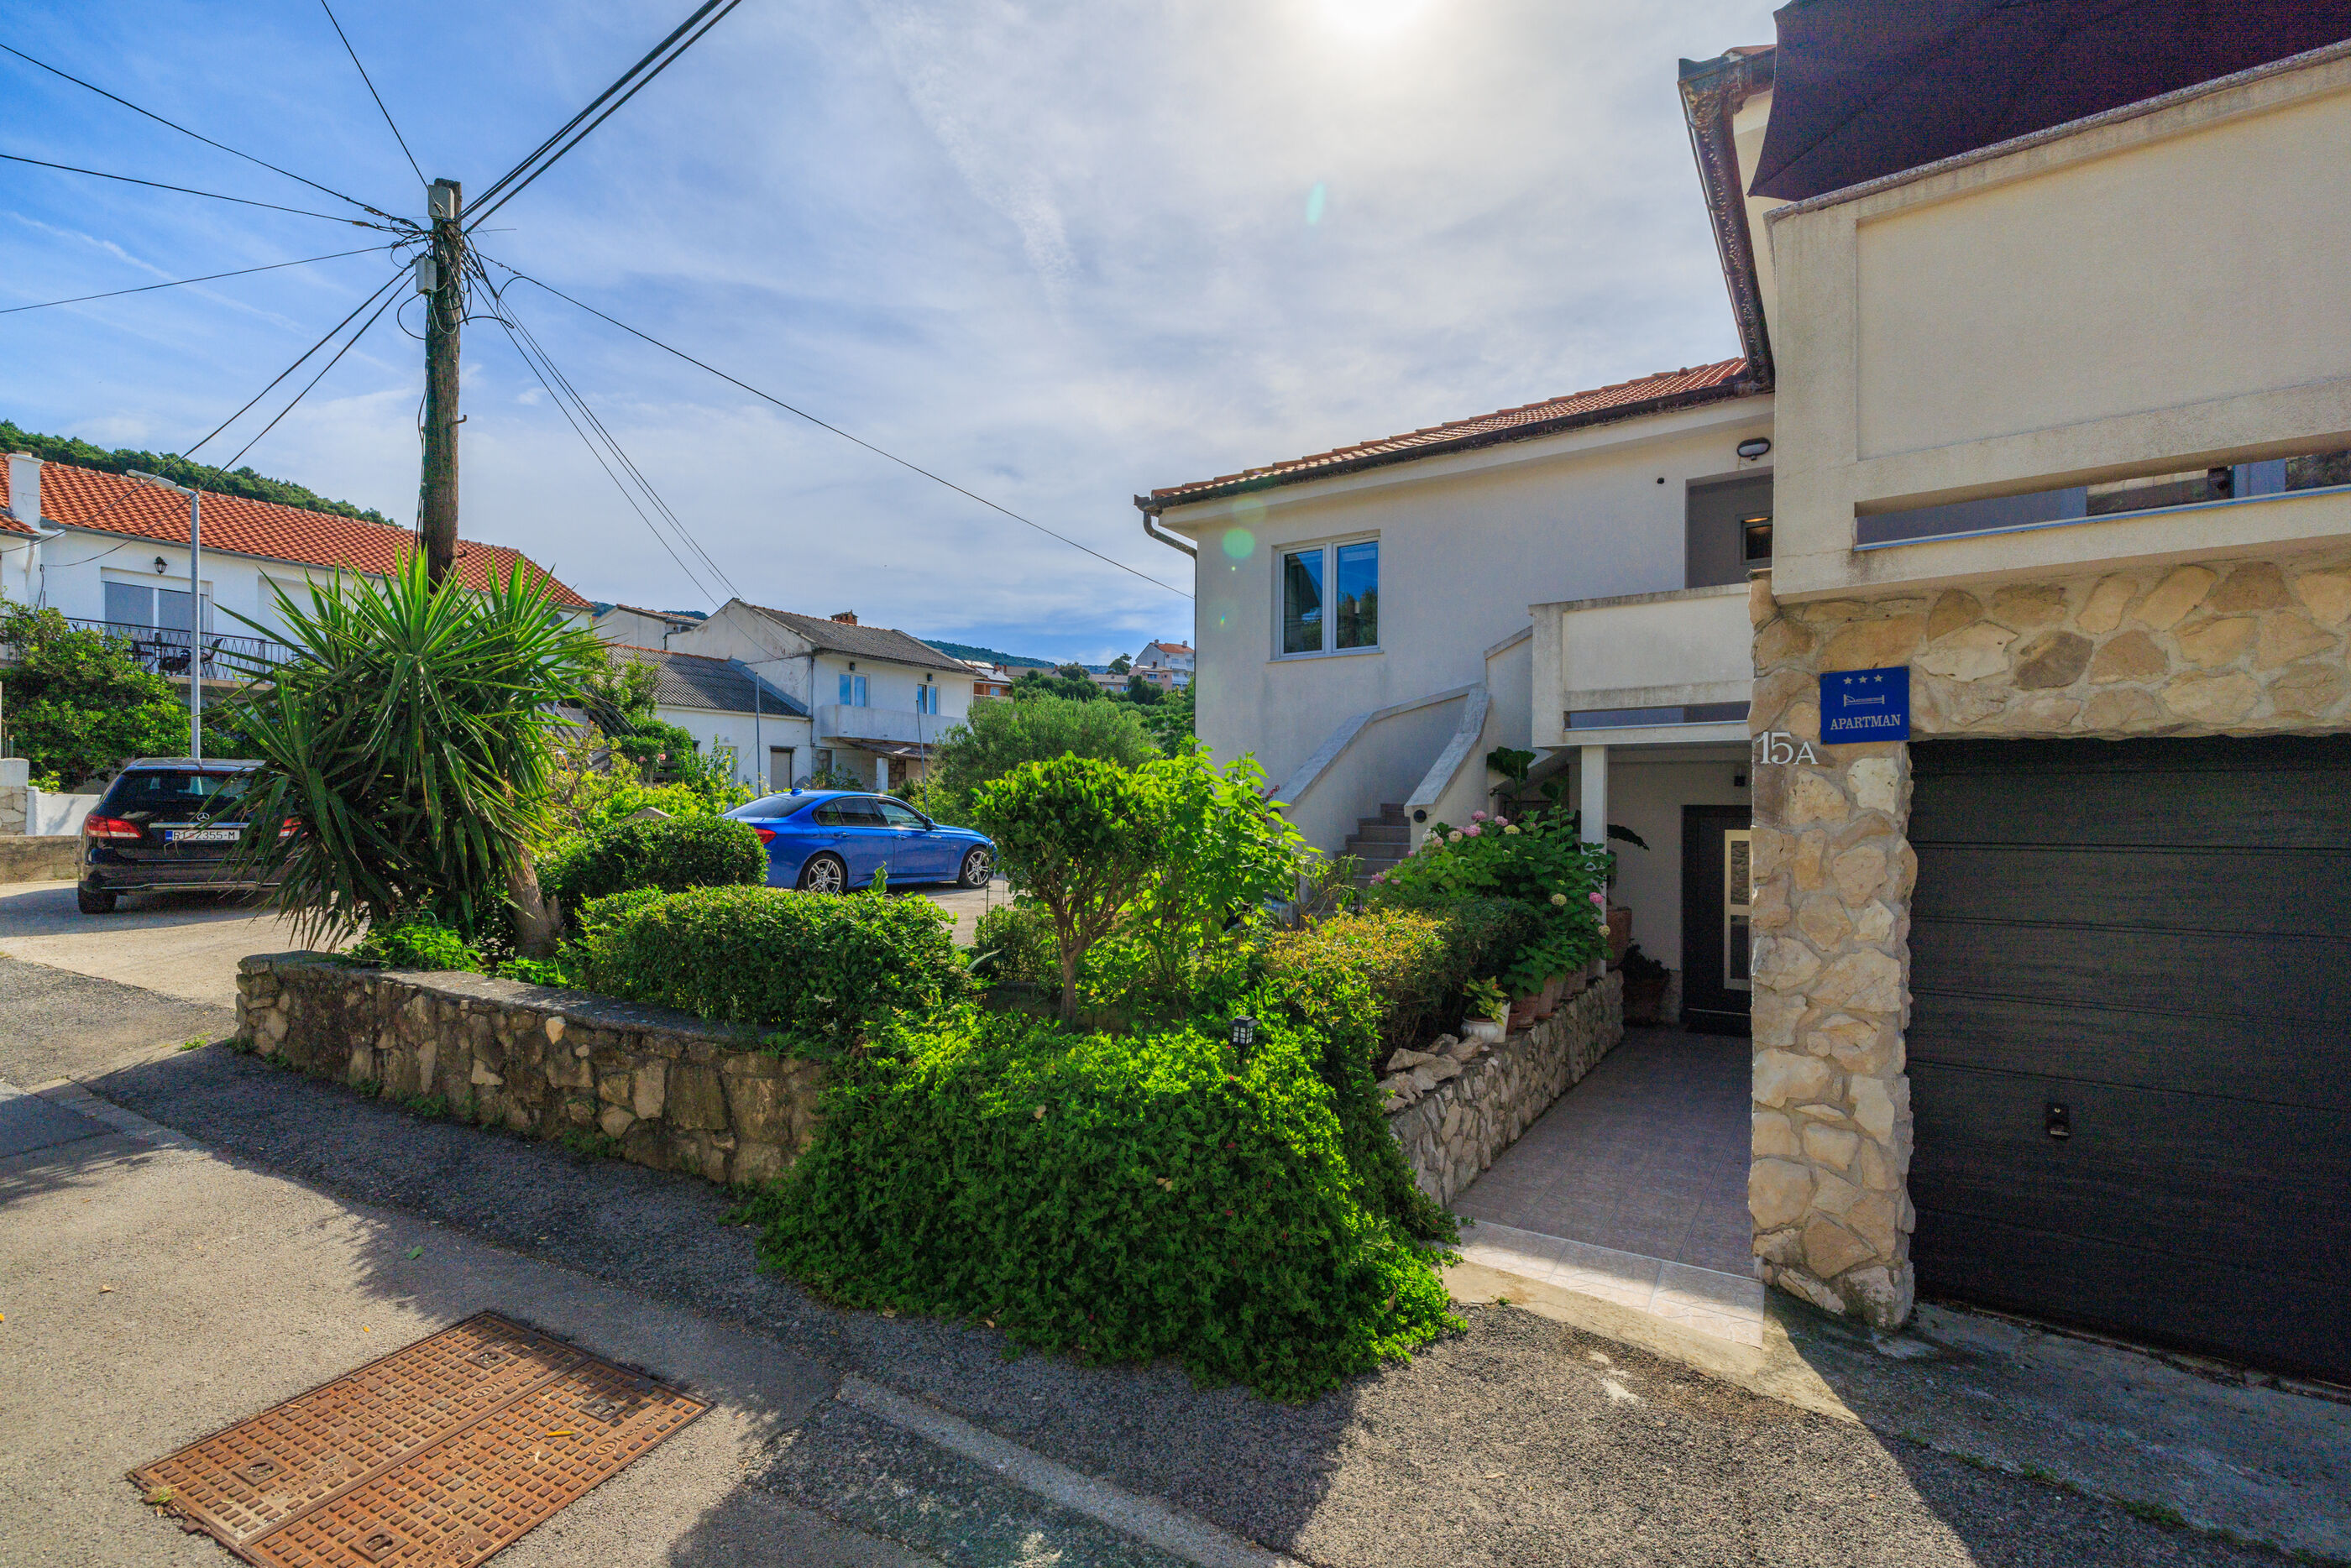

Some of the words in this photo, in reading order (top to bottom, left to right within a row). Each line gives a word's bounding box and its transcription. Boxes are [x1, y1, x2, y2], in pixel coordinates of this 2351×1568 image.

[1830, 713, 1901, 730] APARTMAN
[1756, 731, 1820, 766] 15A
[348, 1393, 418, 1427] TELEFON
[613, 1409, 668, 1442] hedone
[442, 1440, 476, 1459] T-HT
[466, 1451, 535, 1491] TELEFON
